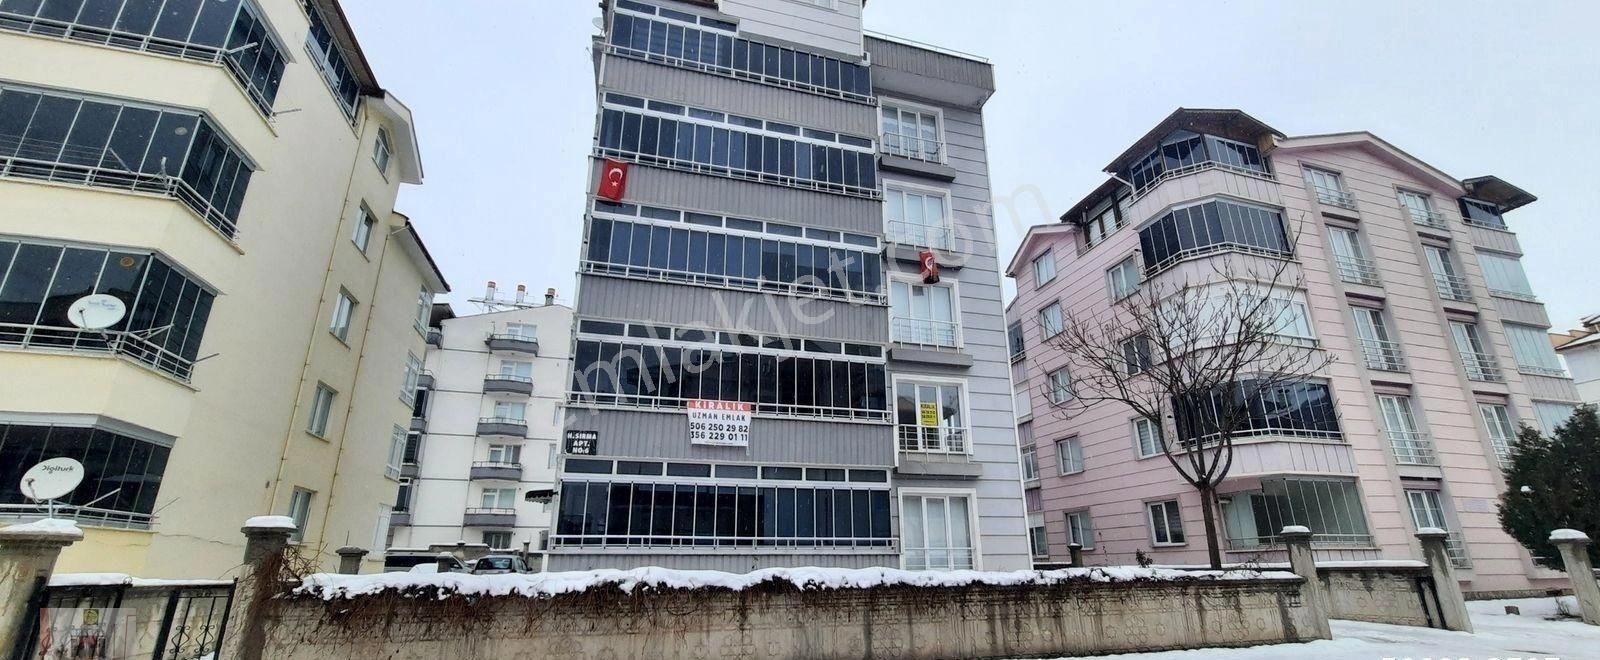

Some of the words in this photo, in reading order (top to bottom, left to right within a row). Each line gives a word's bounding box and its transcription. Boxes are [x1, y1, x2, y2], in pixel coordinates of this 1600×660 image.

[692, 412, 718, 420] UZMAN
[721, 413, 746, 422] EMLAK
[690, 422, 706, 430] 506
[708, 423, 724, 431] 250
[726, 424, 736, 432] 29
[738, 425, 749, 433] 82
[690, 431, 705, 439] 356
[708, 432, 725, 440] 229
[728, 433, 738, 441] 01
